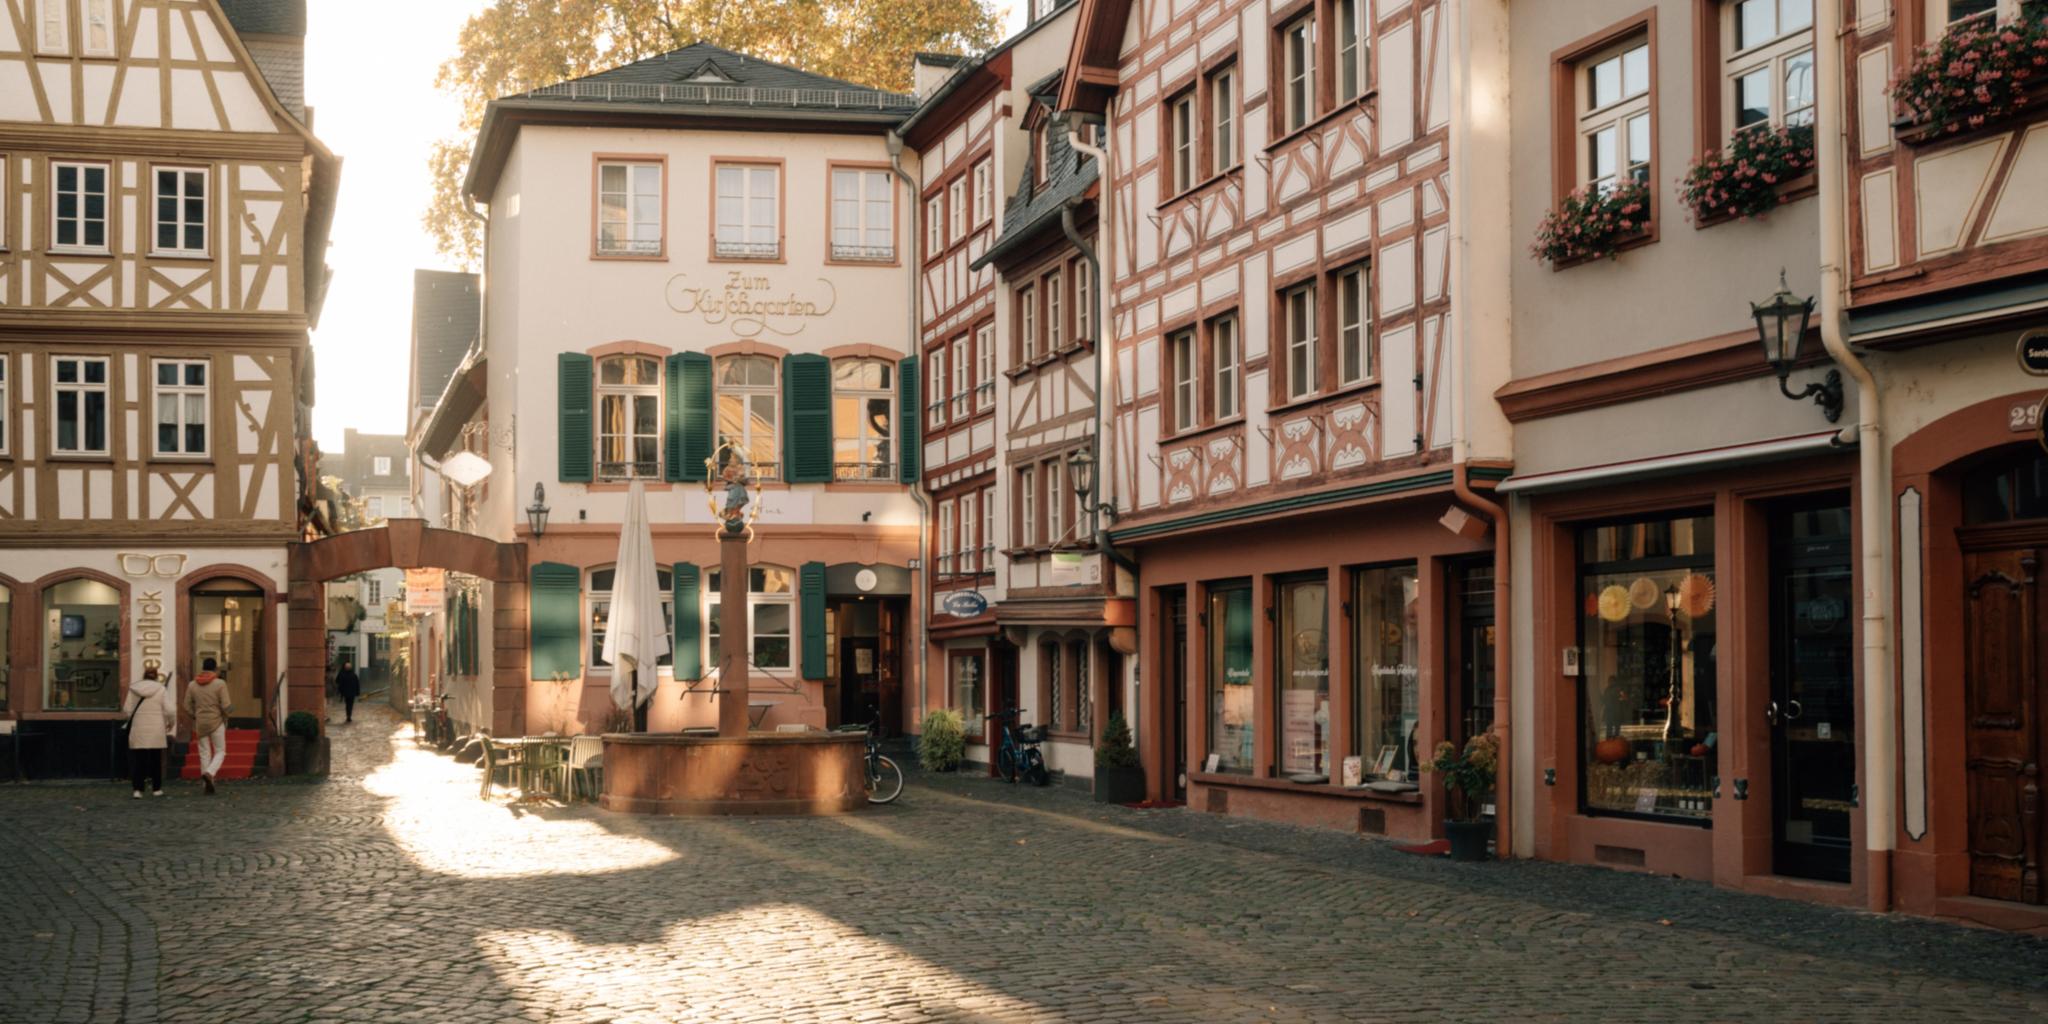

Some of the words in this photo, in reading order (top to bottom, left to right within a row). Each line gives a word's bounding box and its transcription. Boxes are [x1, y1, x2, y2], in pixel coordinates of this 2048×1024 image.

[724, 270, 771, 290] Zum
[2010, 404, 2040, 426] 29
[136, 590, 167, 683] enblick
